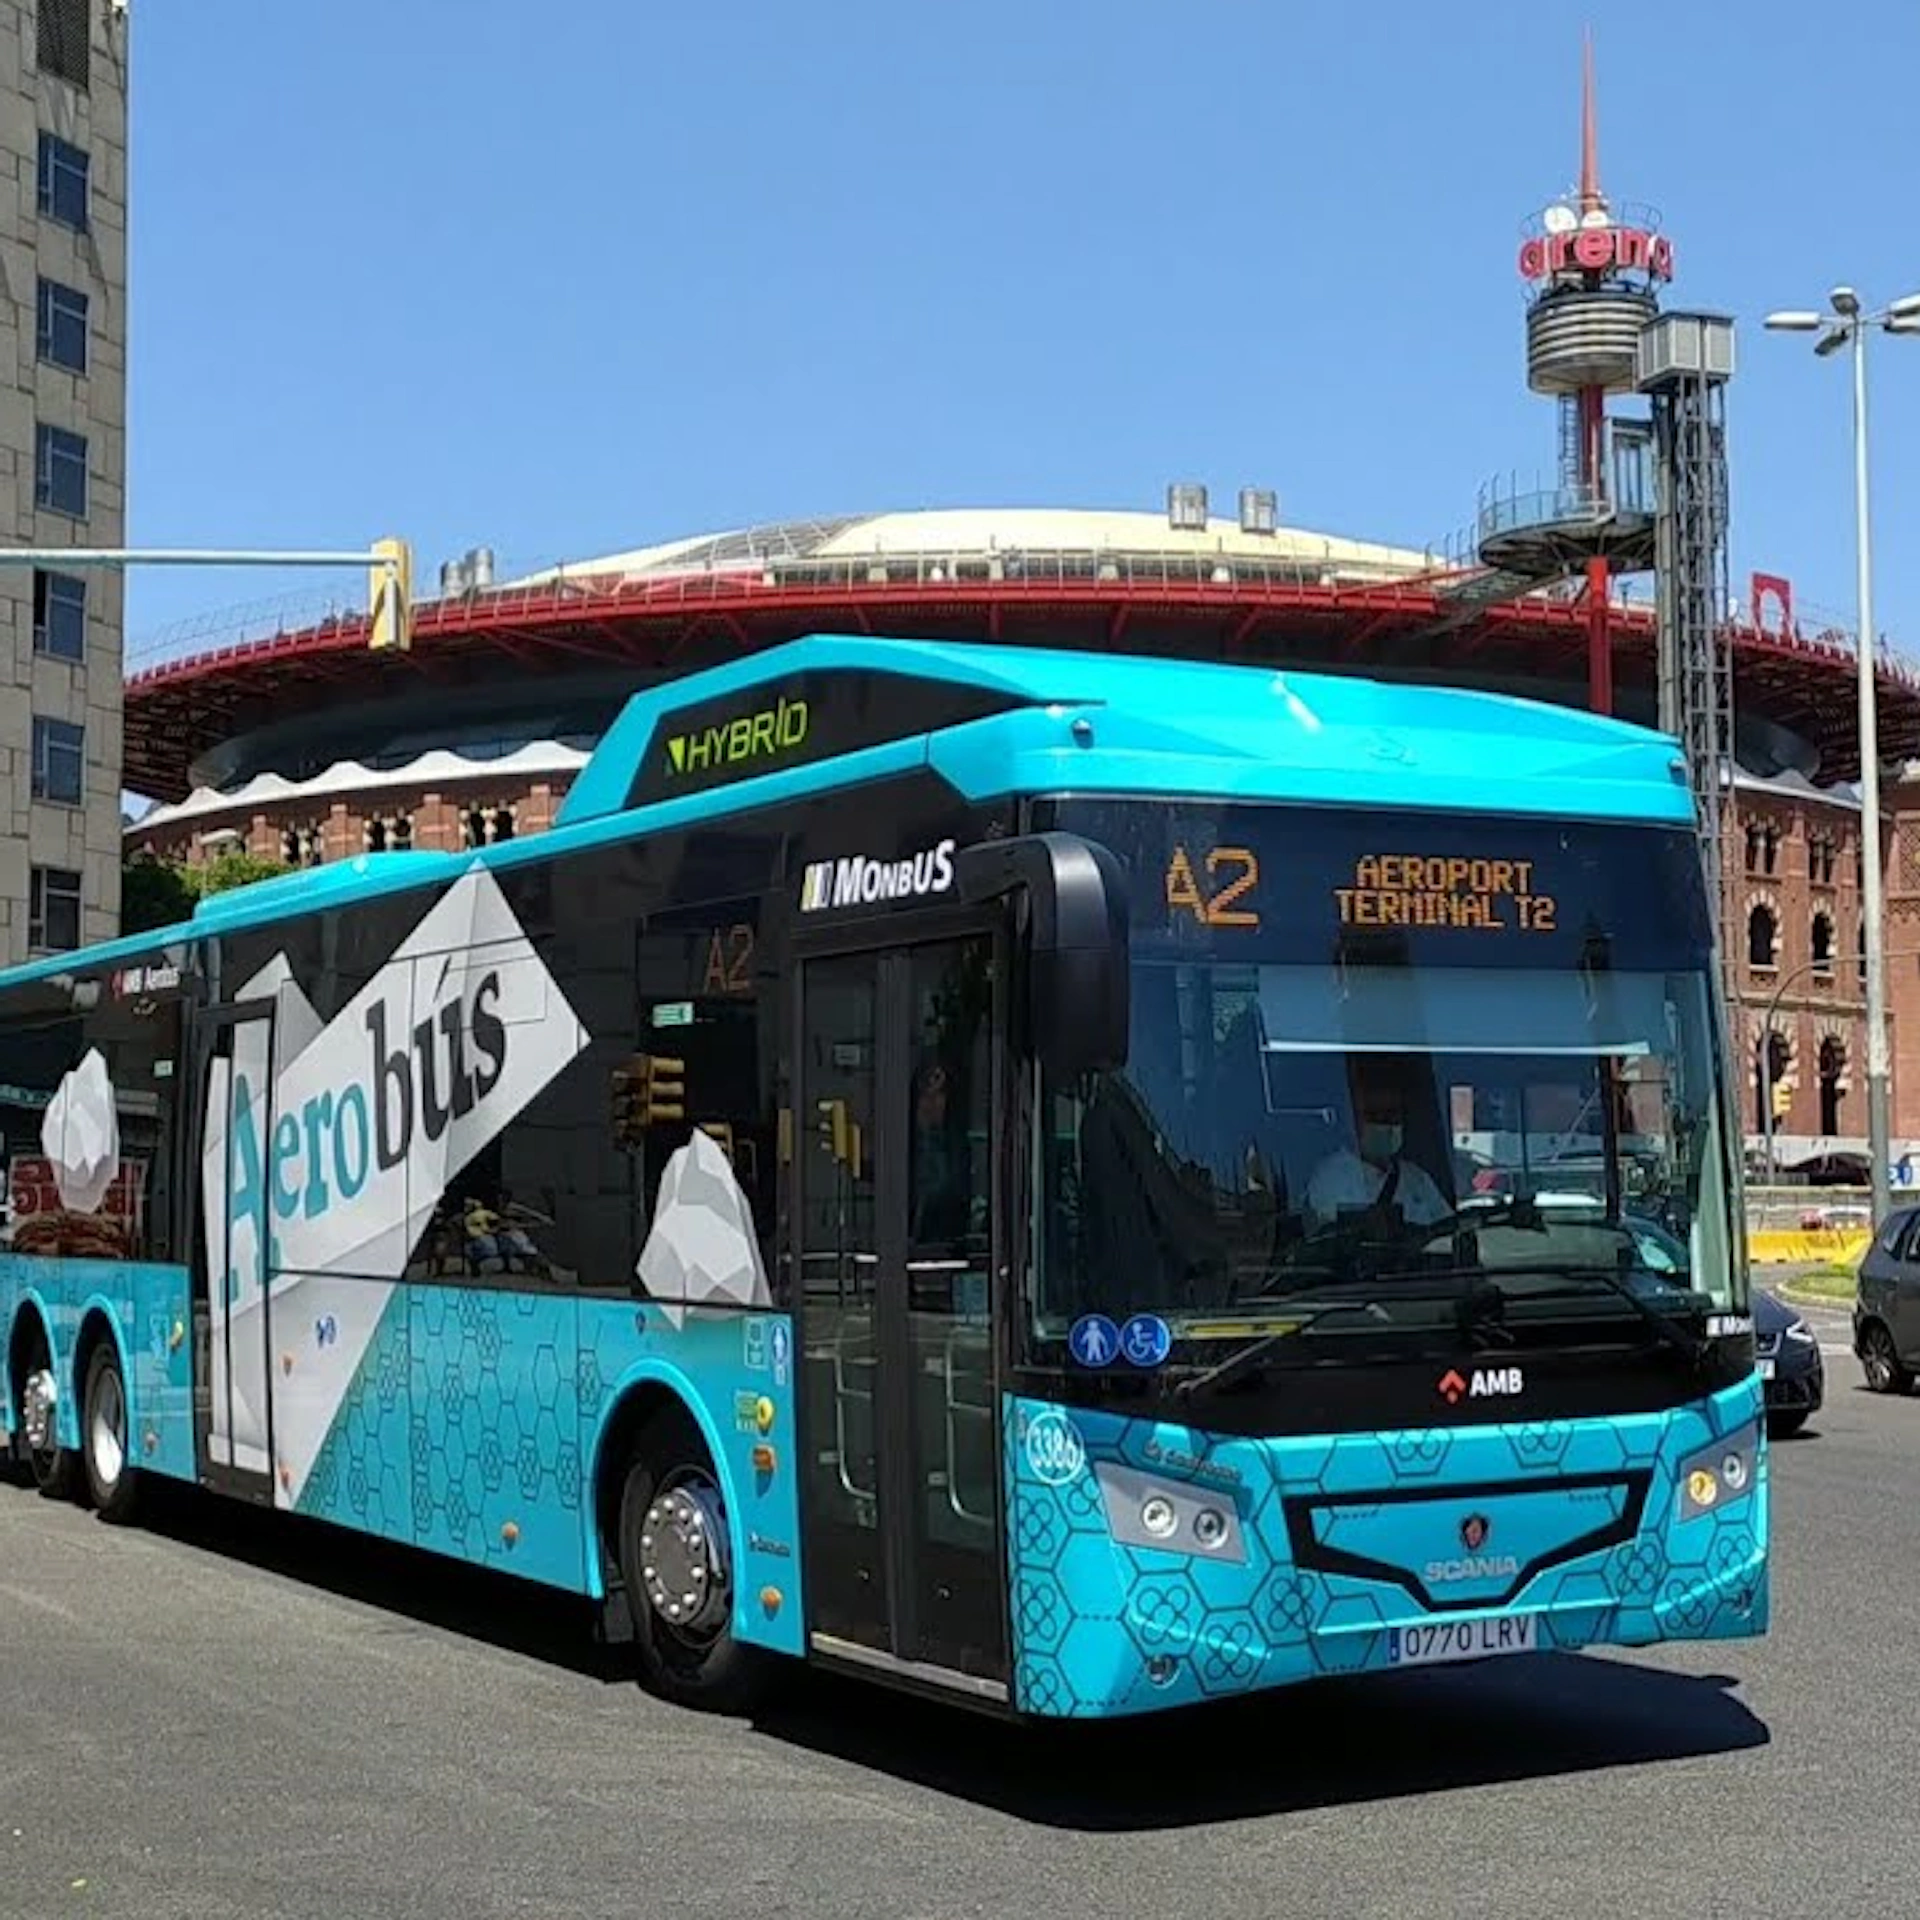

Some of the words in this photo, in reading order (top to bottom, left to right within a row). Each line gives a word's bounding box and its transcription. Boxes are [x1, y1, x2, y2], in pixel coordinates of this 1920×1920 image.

[1518, 228, 1673, 281] arena
[687, 697, 808, 773] HYBRID
[1166, 846, 1260, 925] A2
[1356, 855, 1532, 893] AEROPORT
[1334, 889, 1504, 928] TERMINAL
[1514, 894, 1557, 929] T2
[704, 922, 754, 995] A2
[1469, 1367, 1523, 1397] AMB
[1424, 1555, 1518, 1582] SCANIA
[1405, 1621, 1472, 1657] 0770
[1482, 1616, 1529, 1649] LRV
